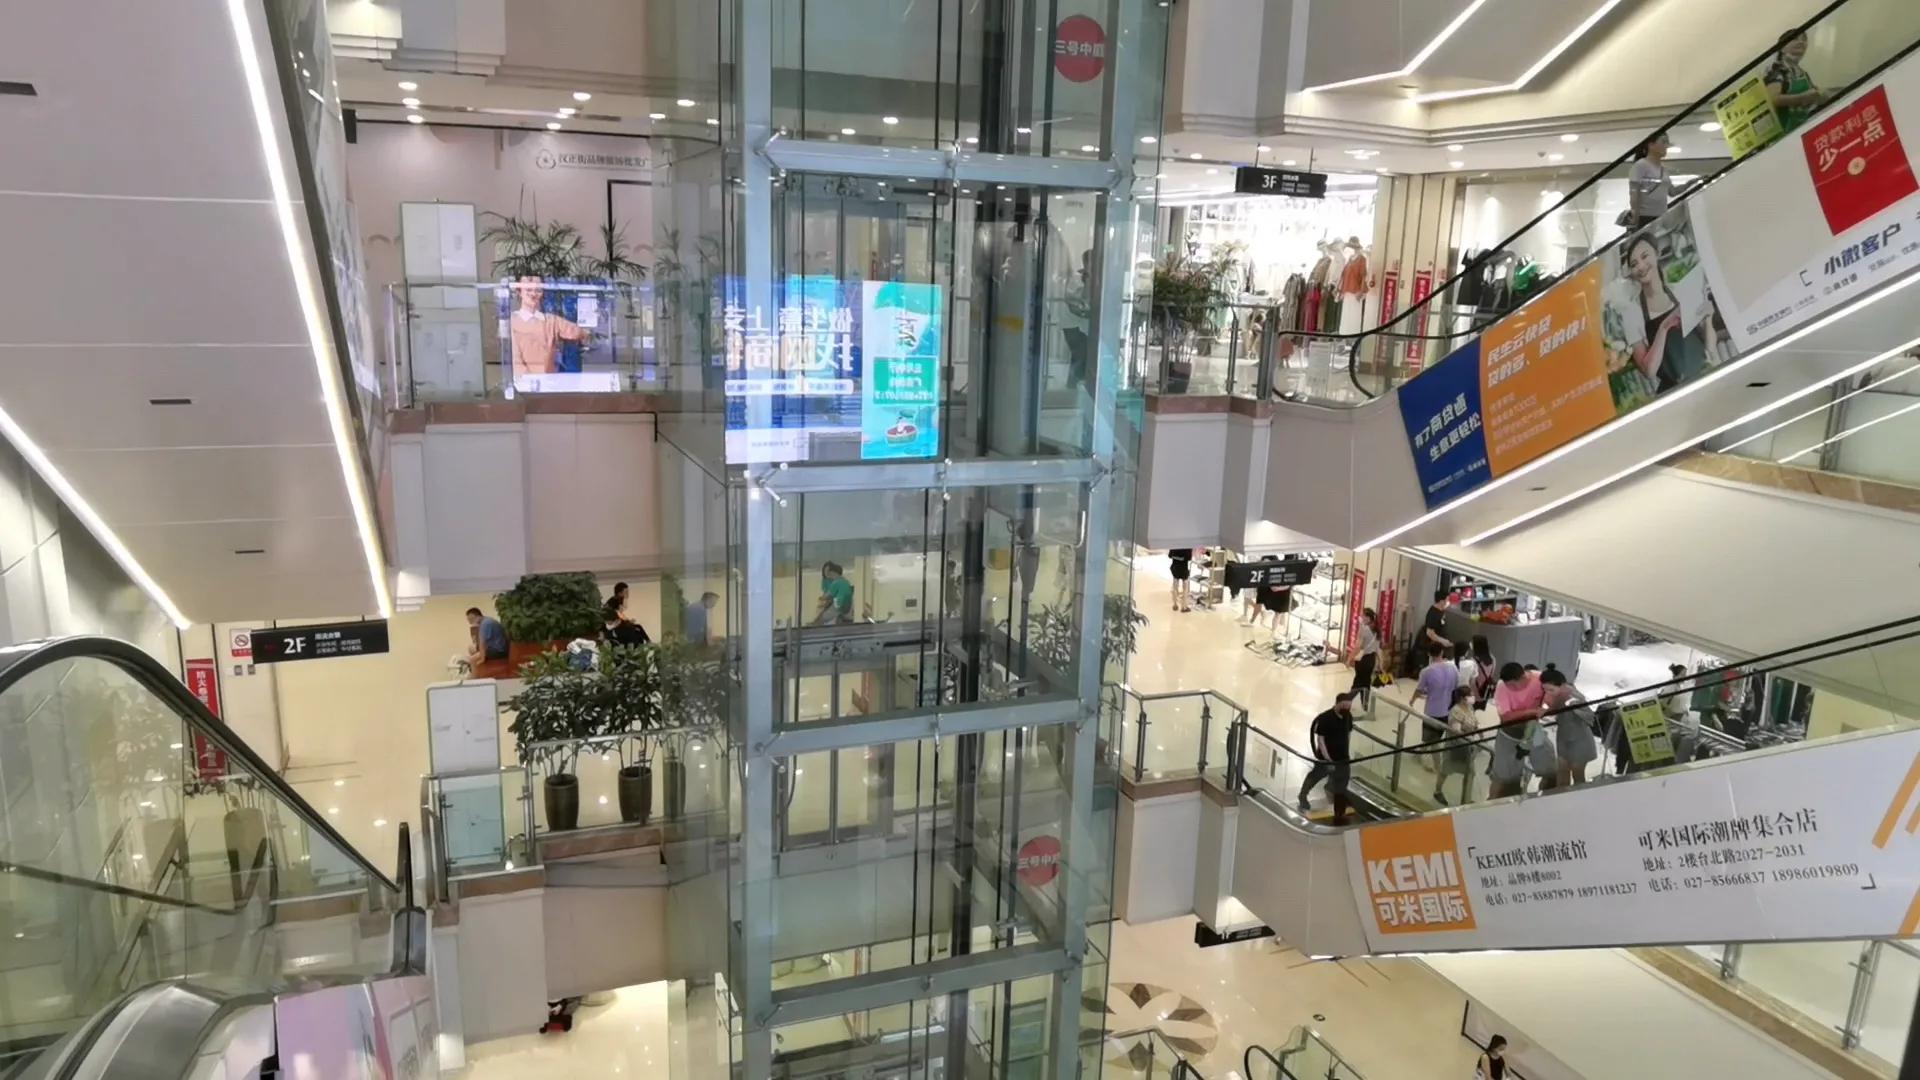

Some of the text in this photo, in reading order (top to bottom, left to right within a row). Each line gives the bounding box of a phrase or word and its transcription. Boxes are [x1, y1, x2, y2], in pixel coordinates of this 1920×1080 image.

[1814, 105, 1879, 153] 贷款利息
[1820, 118, 1886, 172] 少一点
[1262, 174, 1277, 189] 3F
[1824, 223, 1901, 275] 小微客户
[1487, 314, 1552, 367] 民生云快贷
[1414, 392, 1467, 449] 有了商贷通
[1430, 411, 1481, 462] 生意更轻松
[1250, 570, 1265, 583] 2F
[284, 637, 306, 654] 2F
[1638, 808, 1818, 851] 可米国际潮牌集合店
[1368, 851, 1459, 893] KEMI
[1476, 839, 1587, 870] KEMI欧韩潮流馆
[1771, 863, 1859, 883] 18986019809
[1376, 890, 1467, 926] 可米国际
